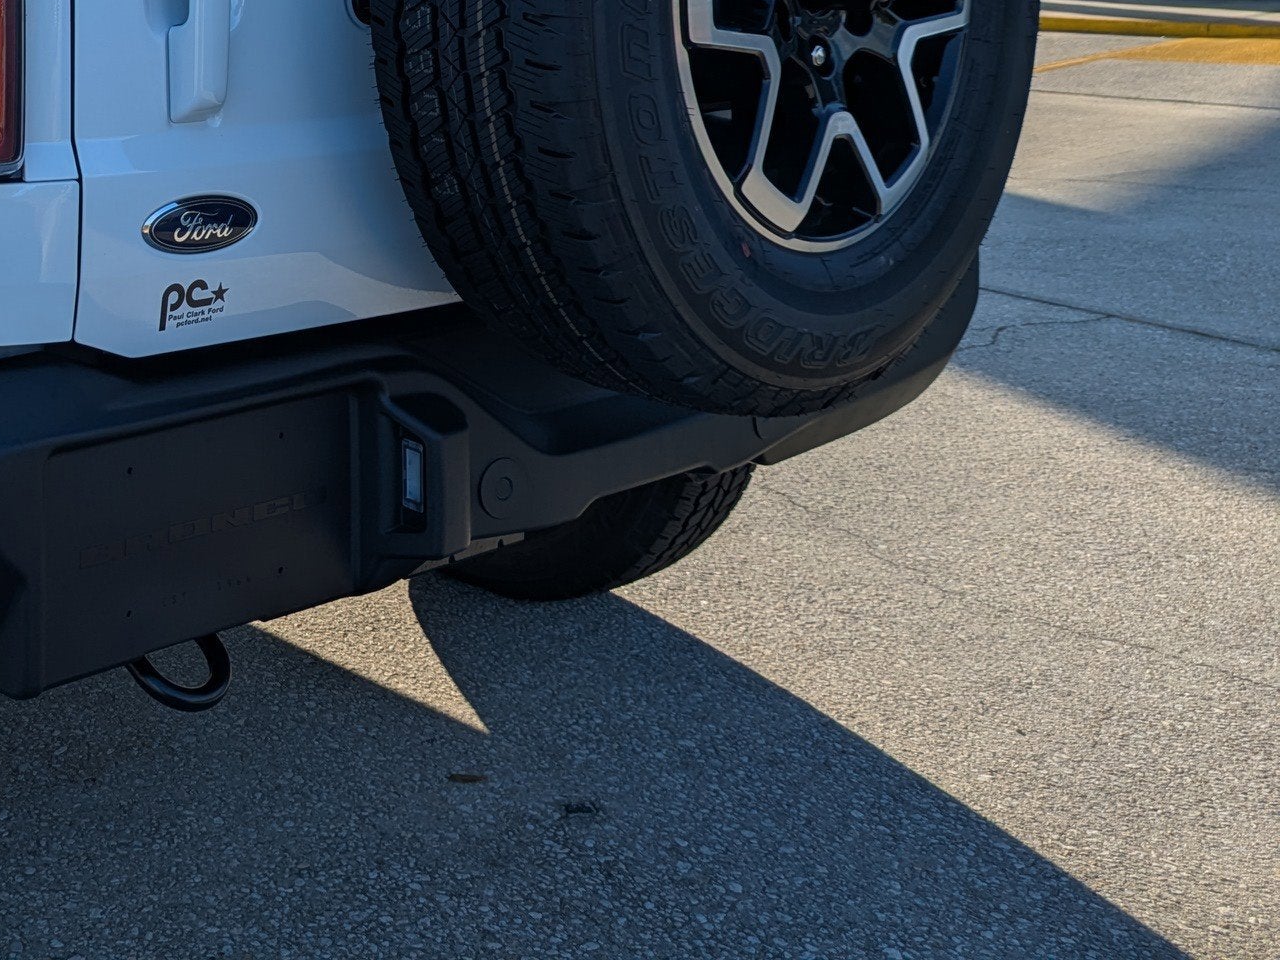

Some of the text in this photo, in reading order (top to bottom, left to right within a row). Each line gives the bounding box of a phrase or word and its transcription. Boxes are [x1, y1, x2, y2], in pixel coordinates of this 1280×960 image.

[174, 210, 234, 243] Ford
[168, 305, 224, 322] Paul Clark Ford
[175, 315, 212, 328] pcford.net
